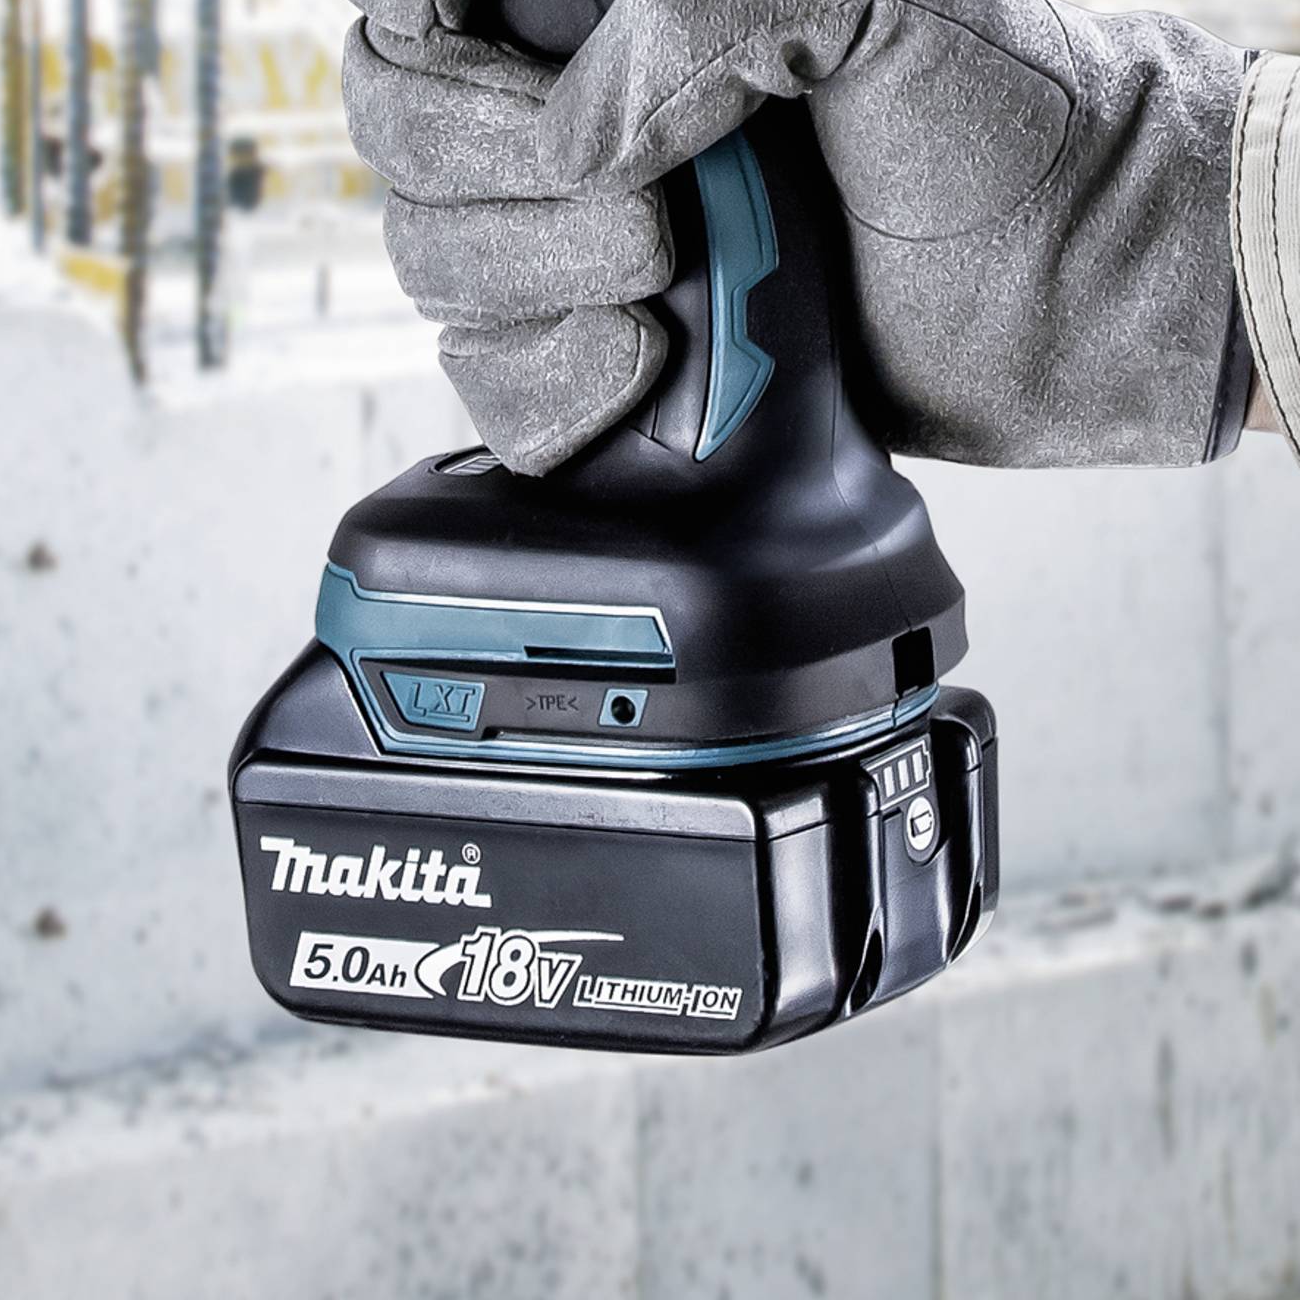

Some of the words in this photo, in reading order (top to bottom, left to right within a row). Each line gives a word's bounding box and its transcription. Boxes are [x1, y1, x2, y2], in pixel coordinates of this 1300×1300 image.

[411, 681, 477, 722] LXT
[303, 942, 408, 988] 5.0Ah
[456, 925, 584, 1009] 18V
[572, 975, 743, 1021] LITHIUM-ION
